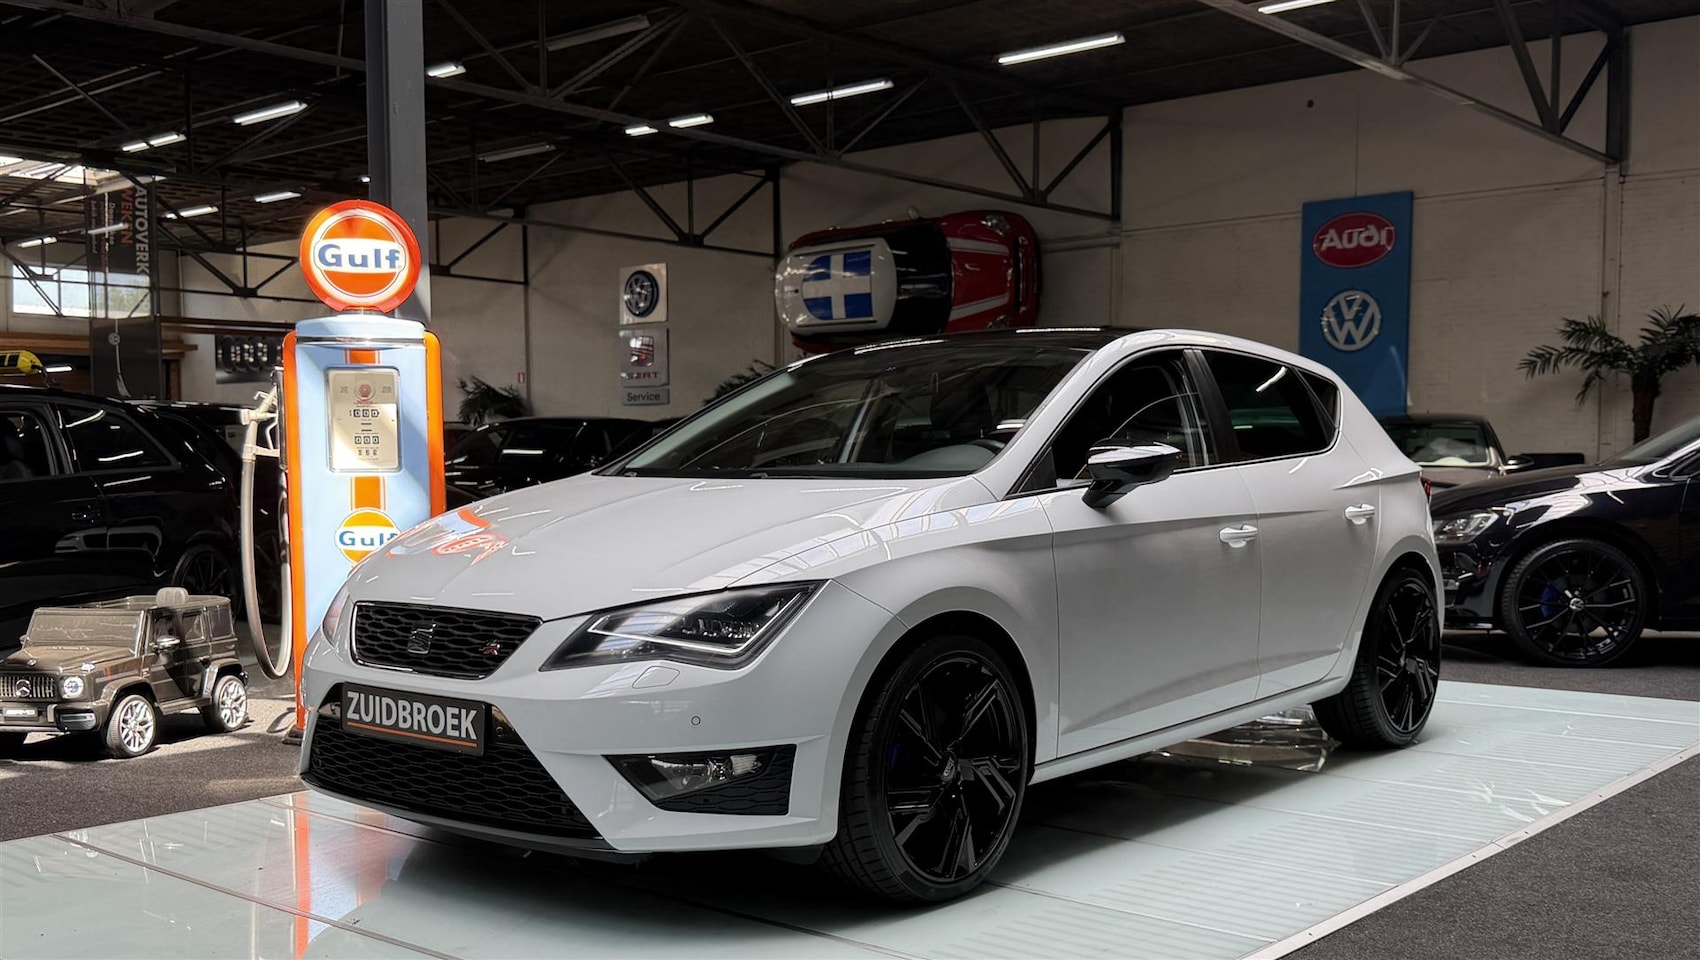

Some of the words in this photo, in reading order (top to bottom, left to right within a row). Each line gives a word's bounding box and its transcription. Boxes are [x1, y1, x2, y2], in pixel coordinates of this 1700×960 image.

[317, 244, 400, 268] Gulf
[626, 392, 661, 402] Service
[346, 691, 477, 740] ZUIDBROEK
